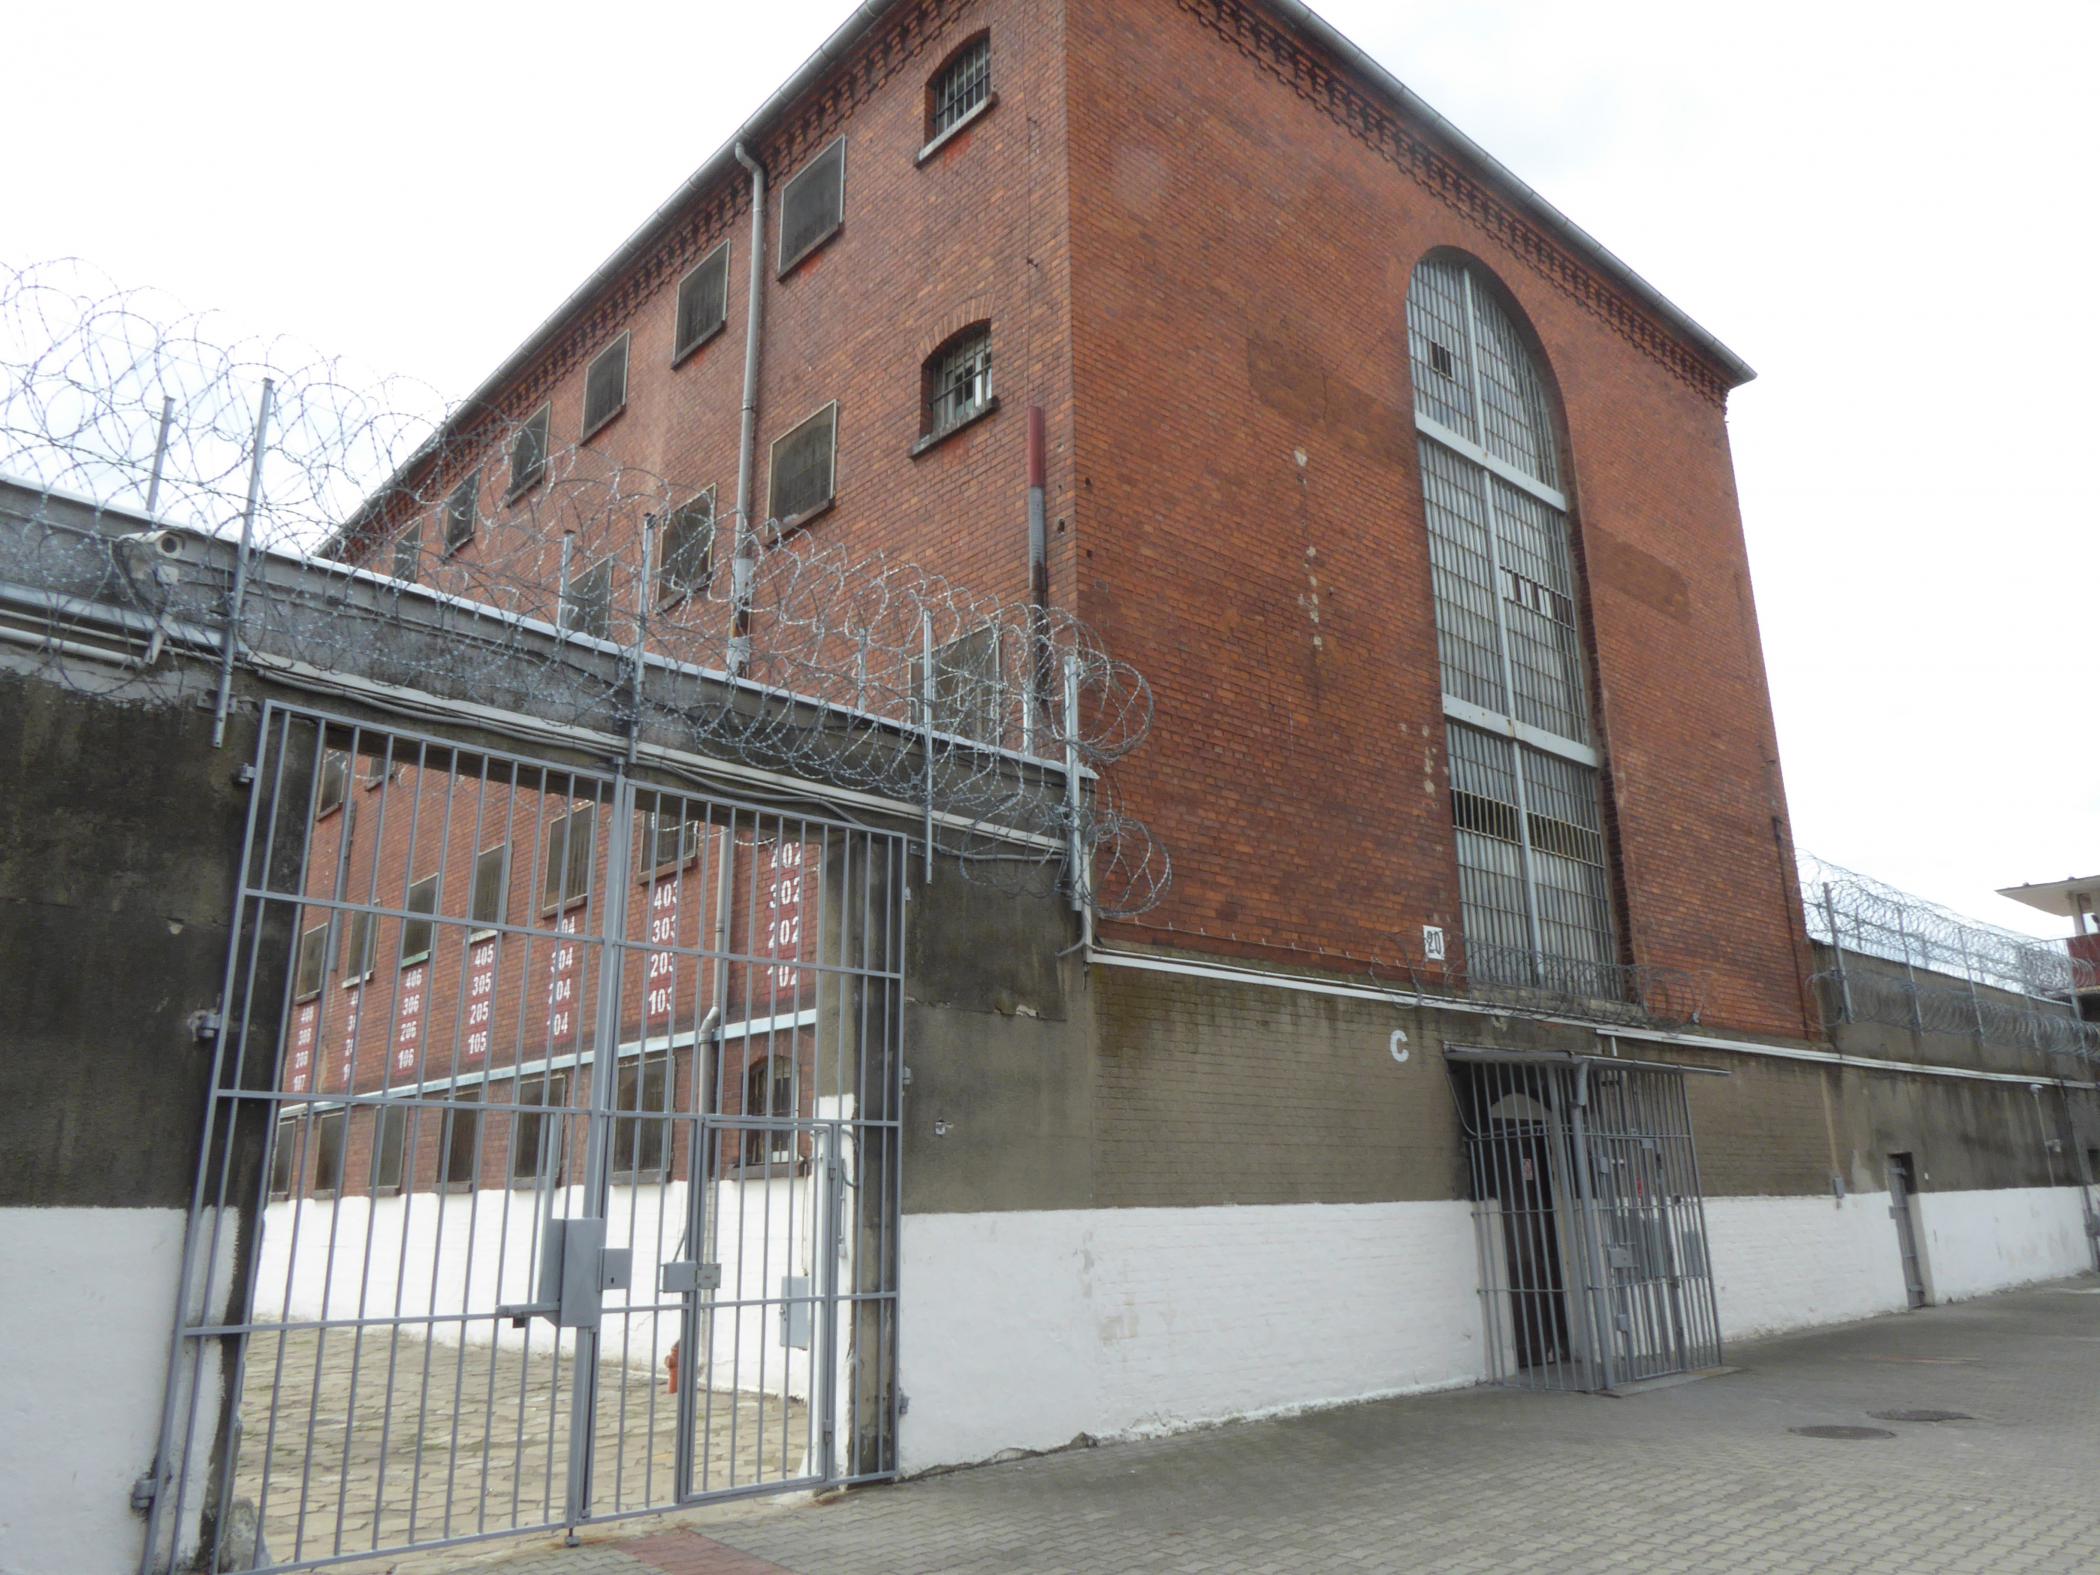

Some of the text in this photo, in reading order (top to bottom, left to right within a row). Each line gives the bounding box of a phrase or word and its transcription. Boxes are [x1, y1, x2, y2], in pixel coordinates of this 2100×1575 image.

[654, 880, 678, 910] 403
[769, 876, 800, 908] 302
[652, 915, 676, 943] 303
[1426, 930, 1442, 955] 20
[474, 944, 494, 967] 405
[650, 952, 674, 978] 203
[405, 968, 422, 988] 406
[472, 972, 492, 996] 305
[402, 994, 420, 1015] 306
[469, 1001, 489, 1024] 205
[648, 987, 673, 1016] 103
[400, 1021, 417, 1042] 206
[468, 1031, 487, 1054] 105
[398, 1048, 414, 1069] 106
[1390, 1030, 1409, 1063] C
